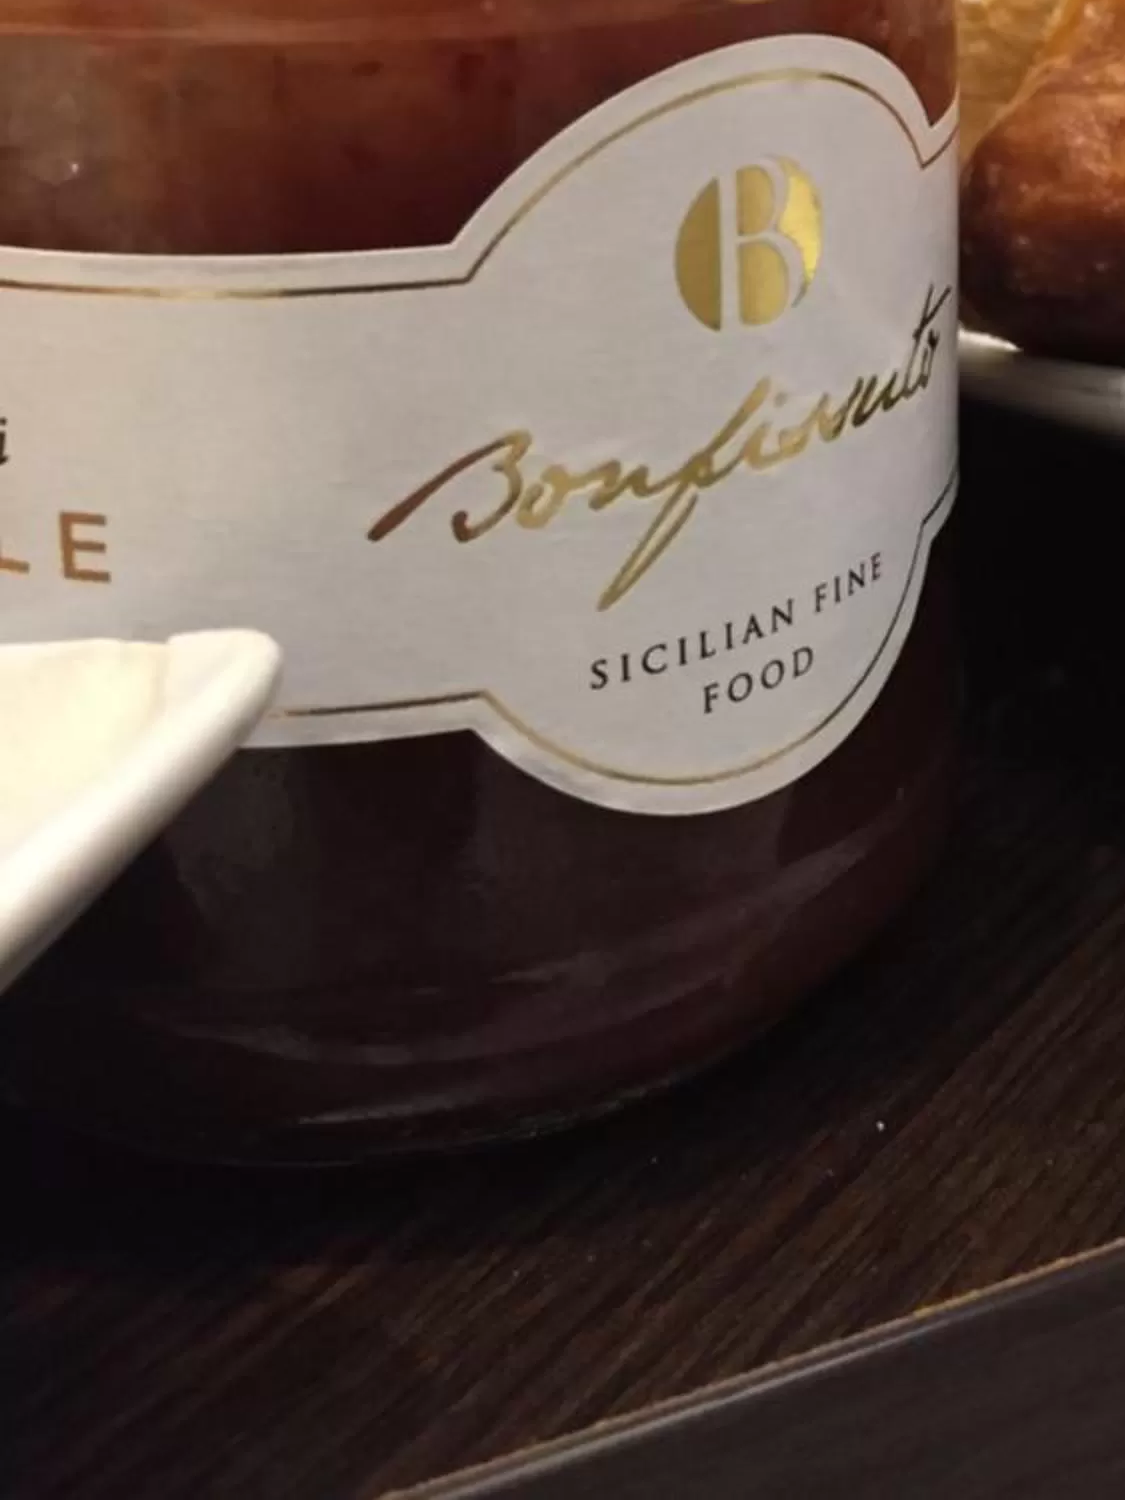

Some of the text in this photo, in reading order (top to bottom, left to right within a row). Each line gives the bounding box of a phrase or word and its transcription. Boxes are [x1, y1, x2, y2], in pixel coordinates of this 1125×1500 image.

[589, 552, 882, 691] SICILIAN FINE
[702, 646, 815, 714] FOOD
